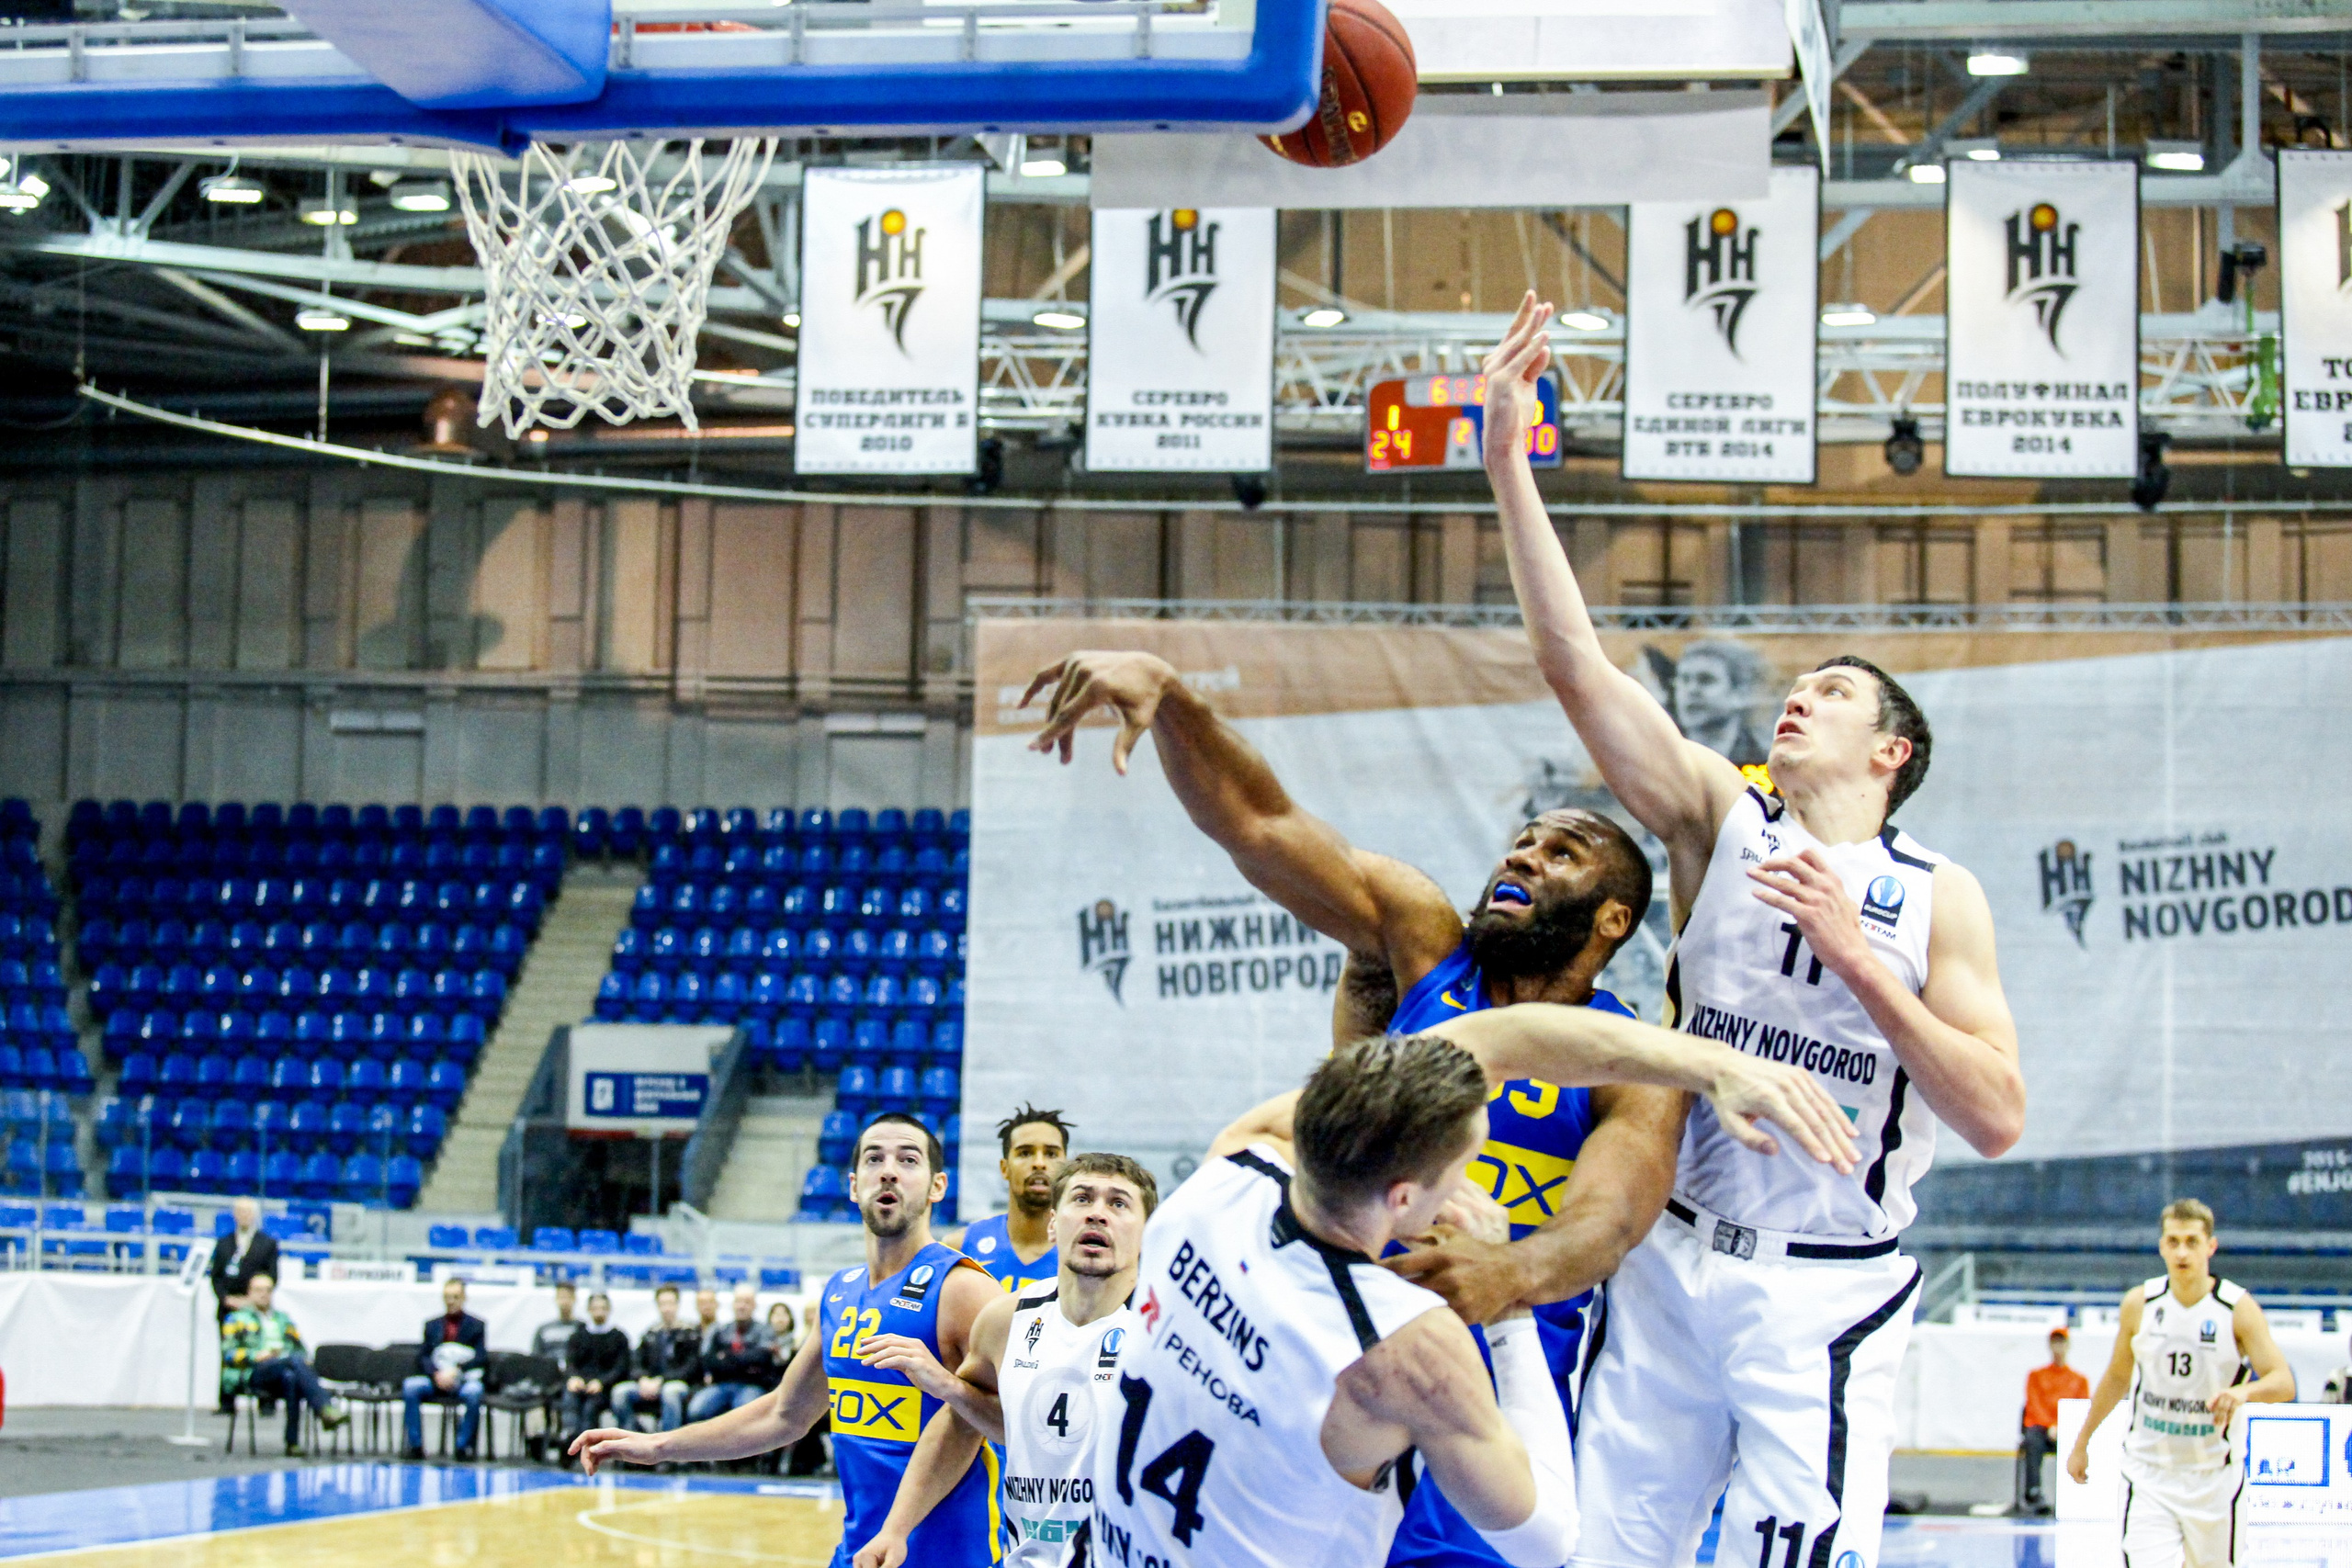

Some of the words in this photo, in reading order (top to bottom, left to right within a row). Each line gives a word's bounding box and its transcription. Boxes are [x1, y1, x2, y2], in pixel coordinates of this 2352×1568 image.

[810, 389, 965, 406] ПОБЕДИТЕЛЬ
[1132, 391, 1228, 407] СЕРЕБРО
[1667, 393, 1774, 410] СЕРЕБРО
[1957, 382, 2128, 400] ПОЛУФИНАЛ
[804, 412, 944, 429] СУПЕРЛИГИ
[1096, 413, 1170, 429] КУБКА
[1180, 413, 1262, 429] РОССИИ
[1962, 410, 2123, 428] ЕВРОКУБКА
[860, 435, 912, 452] 2010
[1155, 433, 1201, 449] 2011
[1721, 441, 1774, 458] 2014
[2013, 436, 2071, 455] 2014
[2120, 847, 2276, 897] NIZHNY
[2123, 887, 2352, 942] NOVGOROD
[1159, 952, 1341, 997] НОВГОРОД
[1687, 1003, 1758, 1052] NIZHNY
[1756, 1024, 1876, 1085] NOVGOROD
[1170, 1239, 1269, 1371] BERZINS
[831, 1306, 882, 1359] 22
[2167, 1352, 2192, 1376] 13
[1046, 1393, 1069, 1437] 4
[1116, 1369, 1215, 1549] 14
[1005, 1476, 1045, 1504] NIZHNY
[1755, 1516, 1805, 1568] 11
